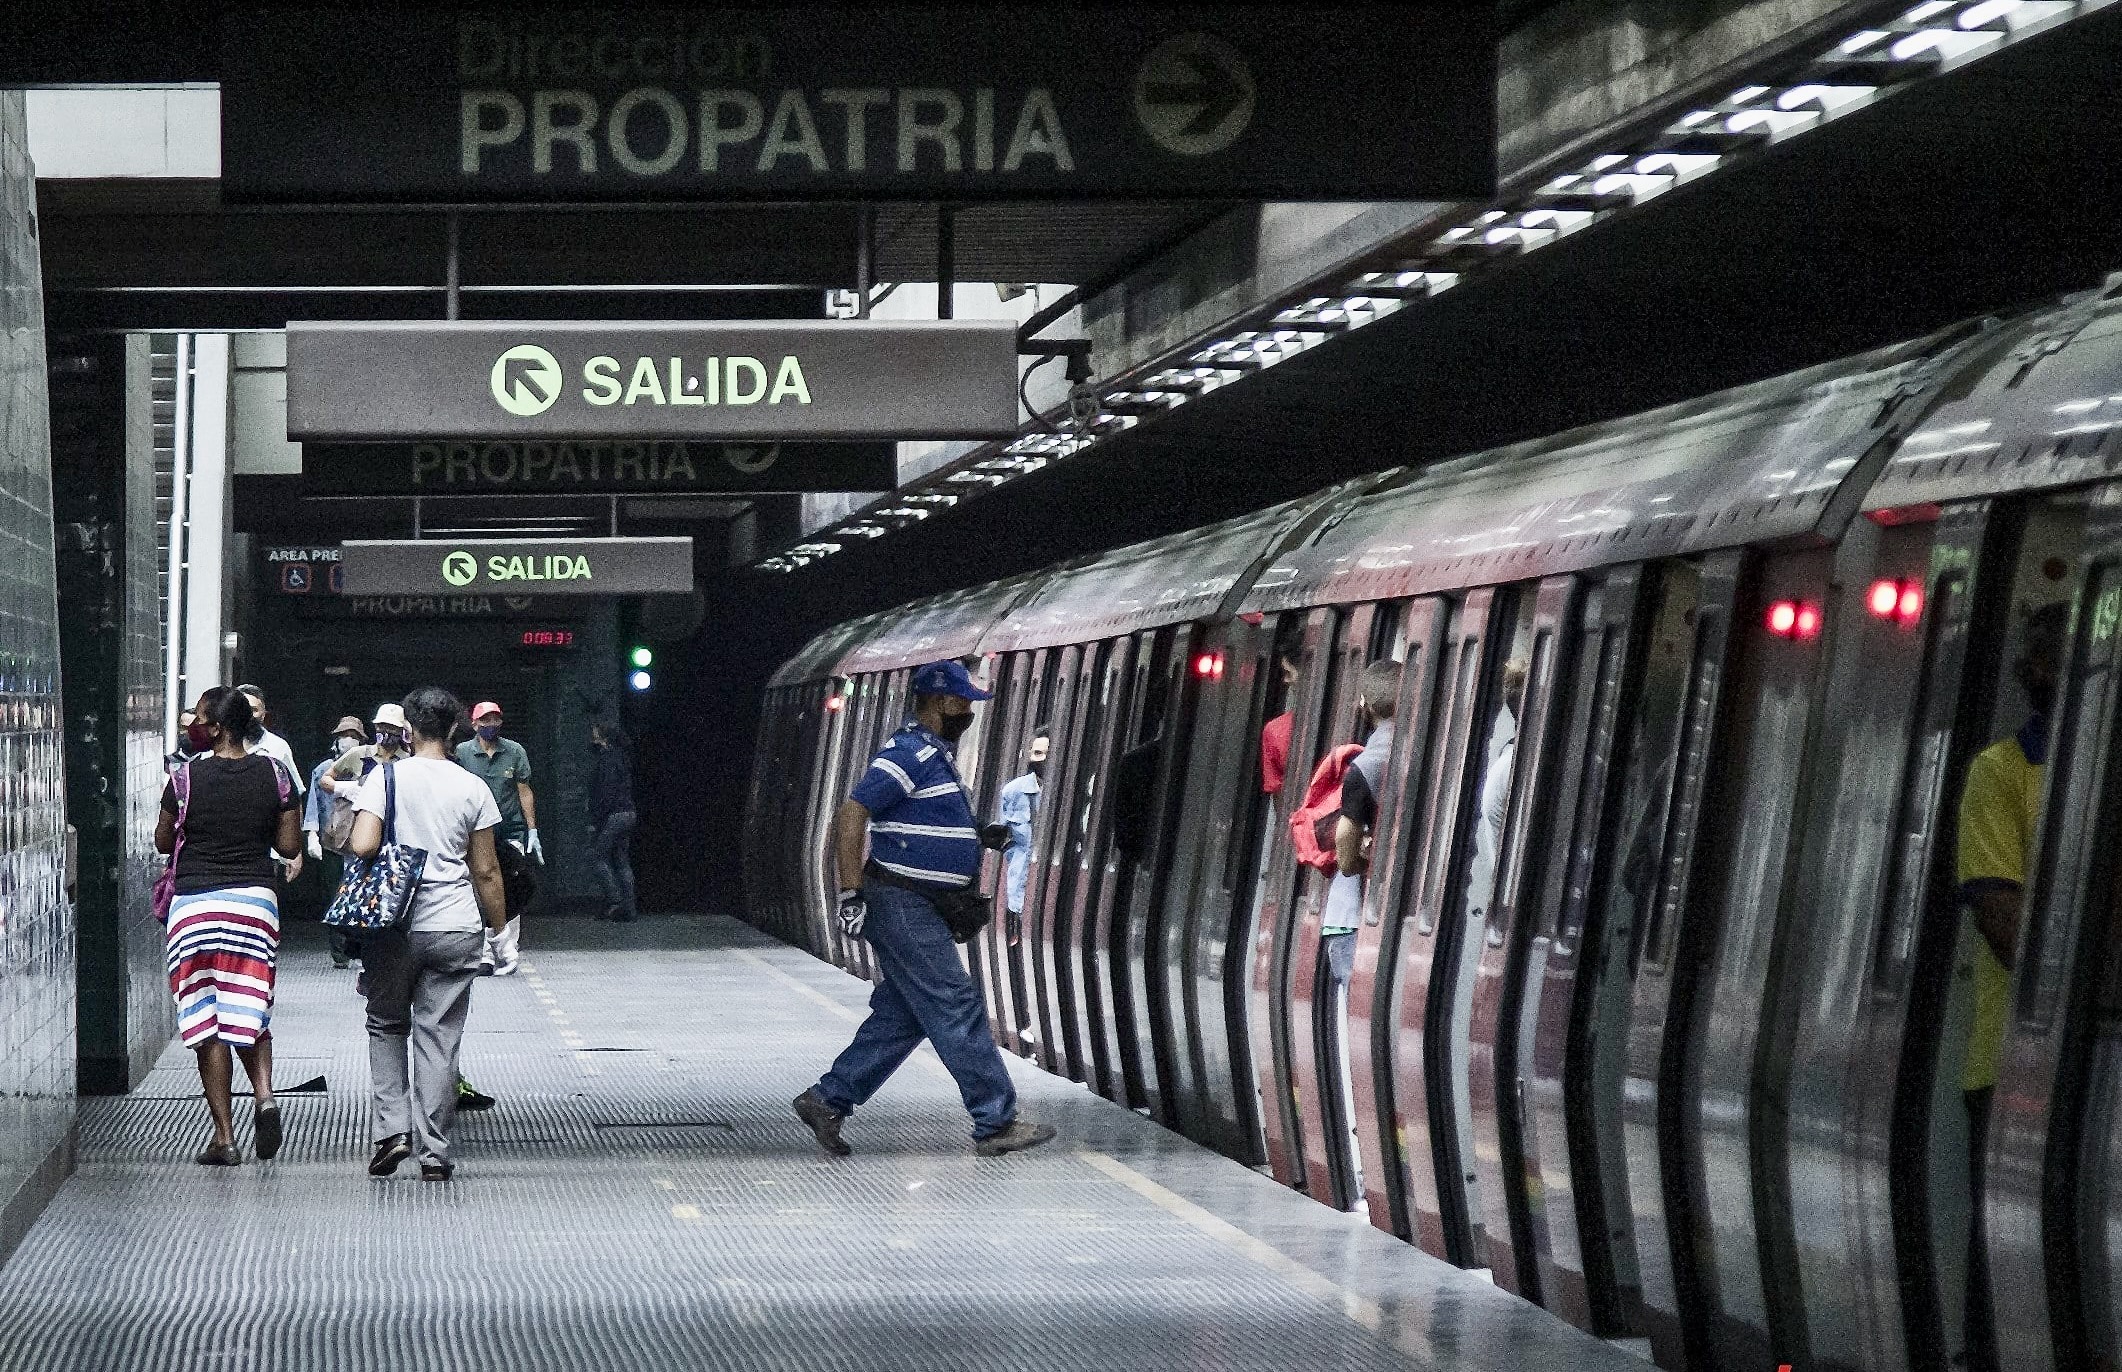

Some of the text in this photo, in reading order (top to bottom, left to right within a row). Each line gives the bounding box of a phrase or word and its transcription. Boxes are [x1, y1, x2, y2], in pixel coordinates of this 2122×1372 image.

[460, 87, 1076, 177] PROPATRIA
[582, 354, 813, 407] SALIDA
[412, 441, 698, 483] PROPATRIA
[488, 555, 592, 581] SALIDA
